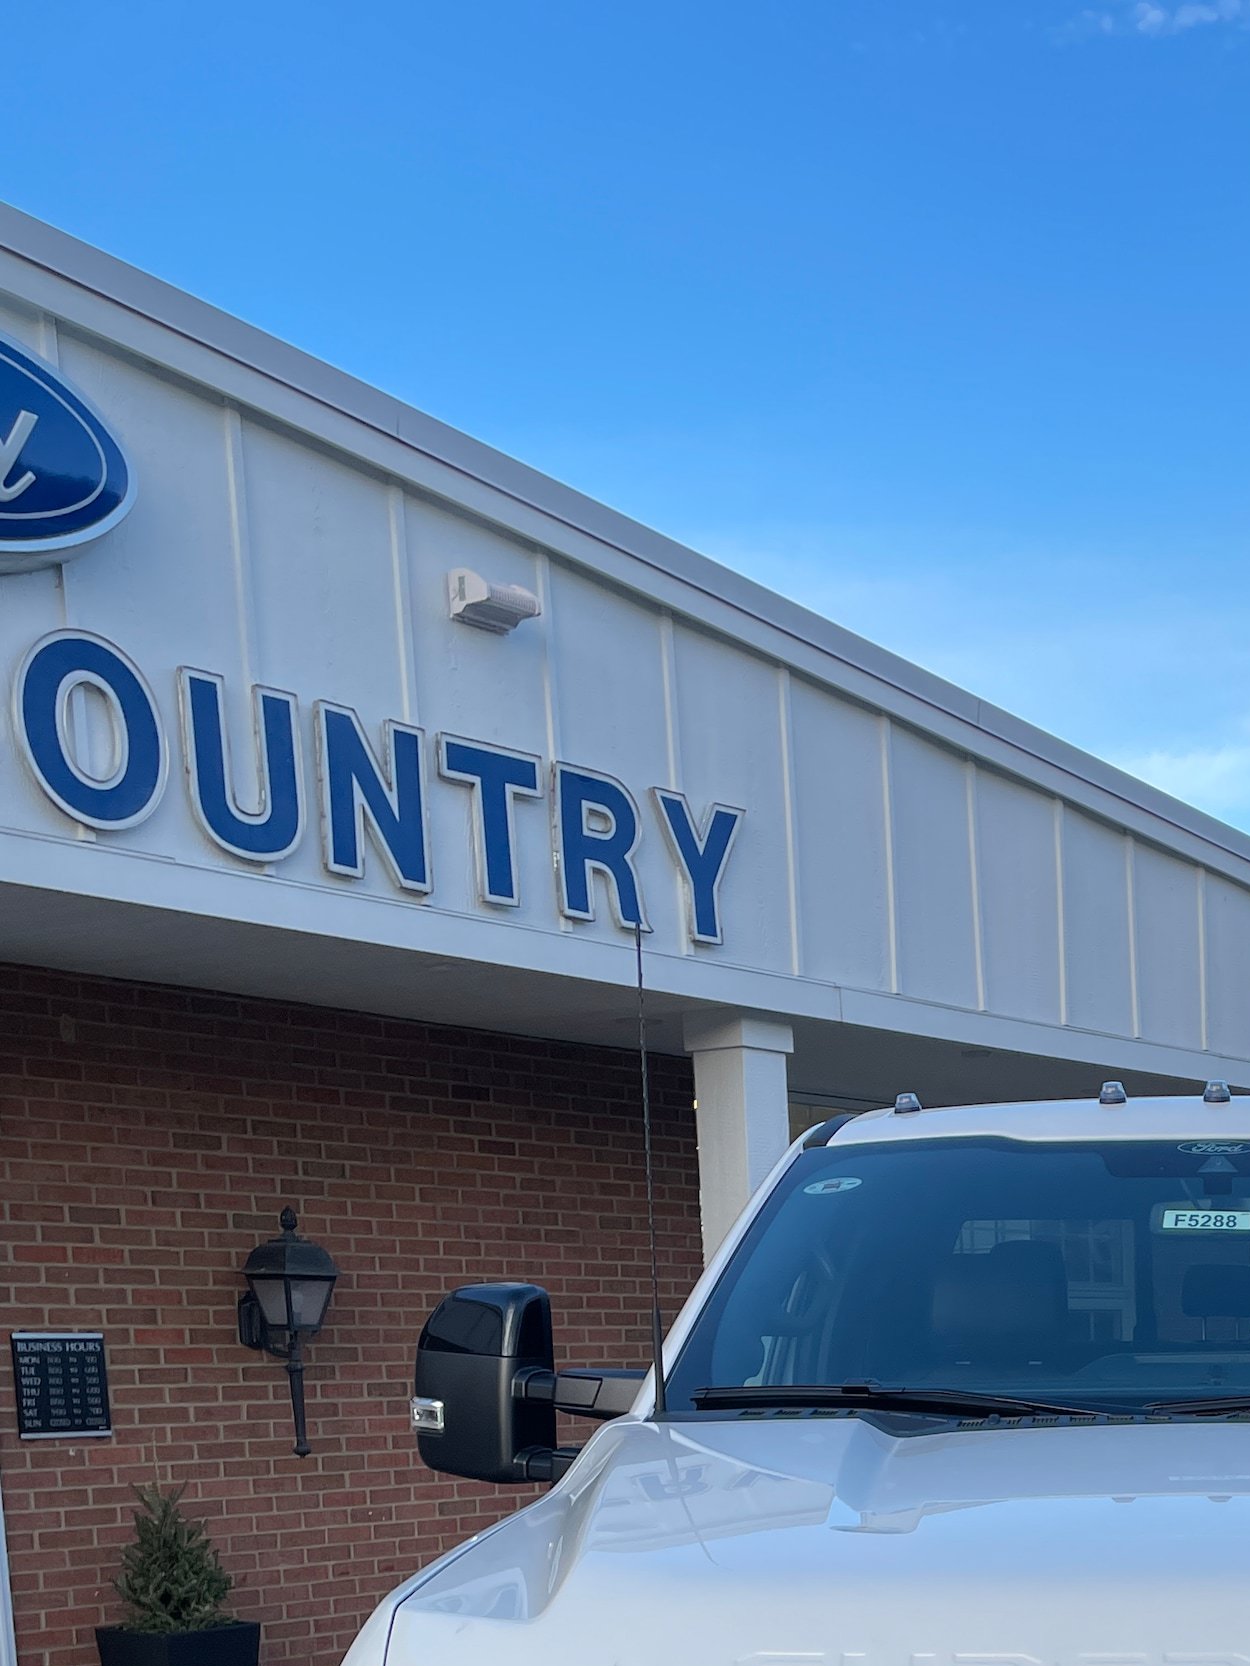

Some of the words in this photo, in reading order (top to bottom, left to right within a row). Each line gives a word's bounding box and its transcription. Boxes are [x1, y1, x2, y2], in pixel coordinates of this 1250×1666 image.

[1191, 1142, 1244, 1153] Ford
[1174, 1213, 1238, 1228] F5288
[16, 1341, 63, 1353] BUSINESS
[65, 1341, 101, 1352] HOURS
